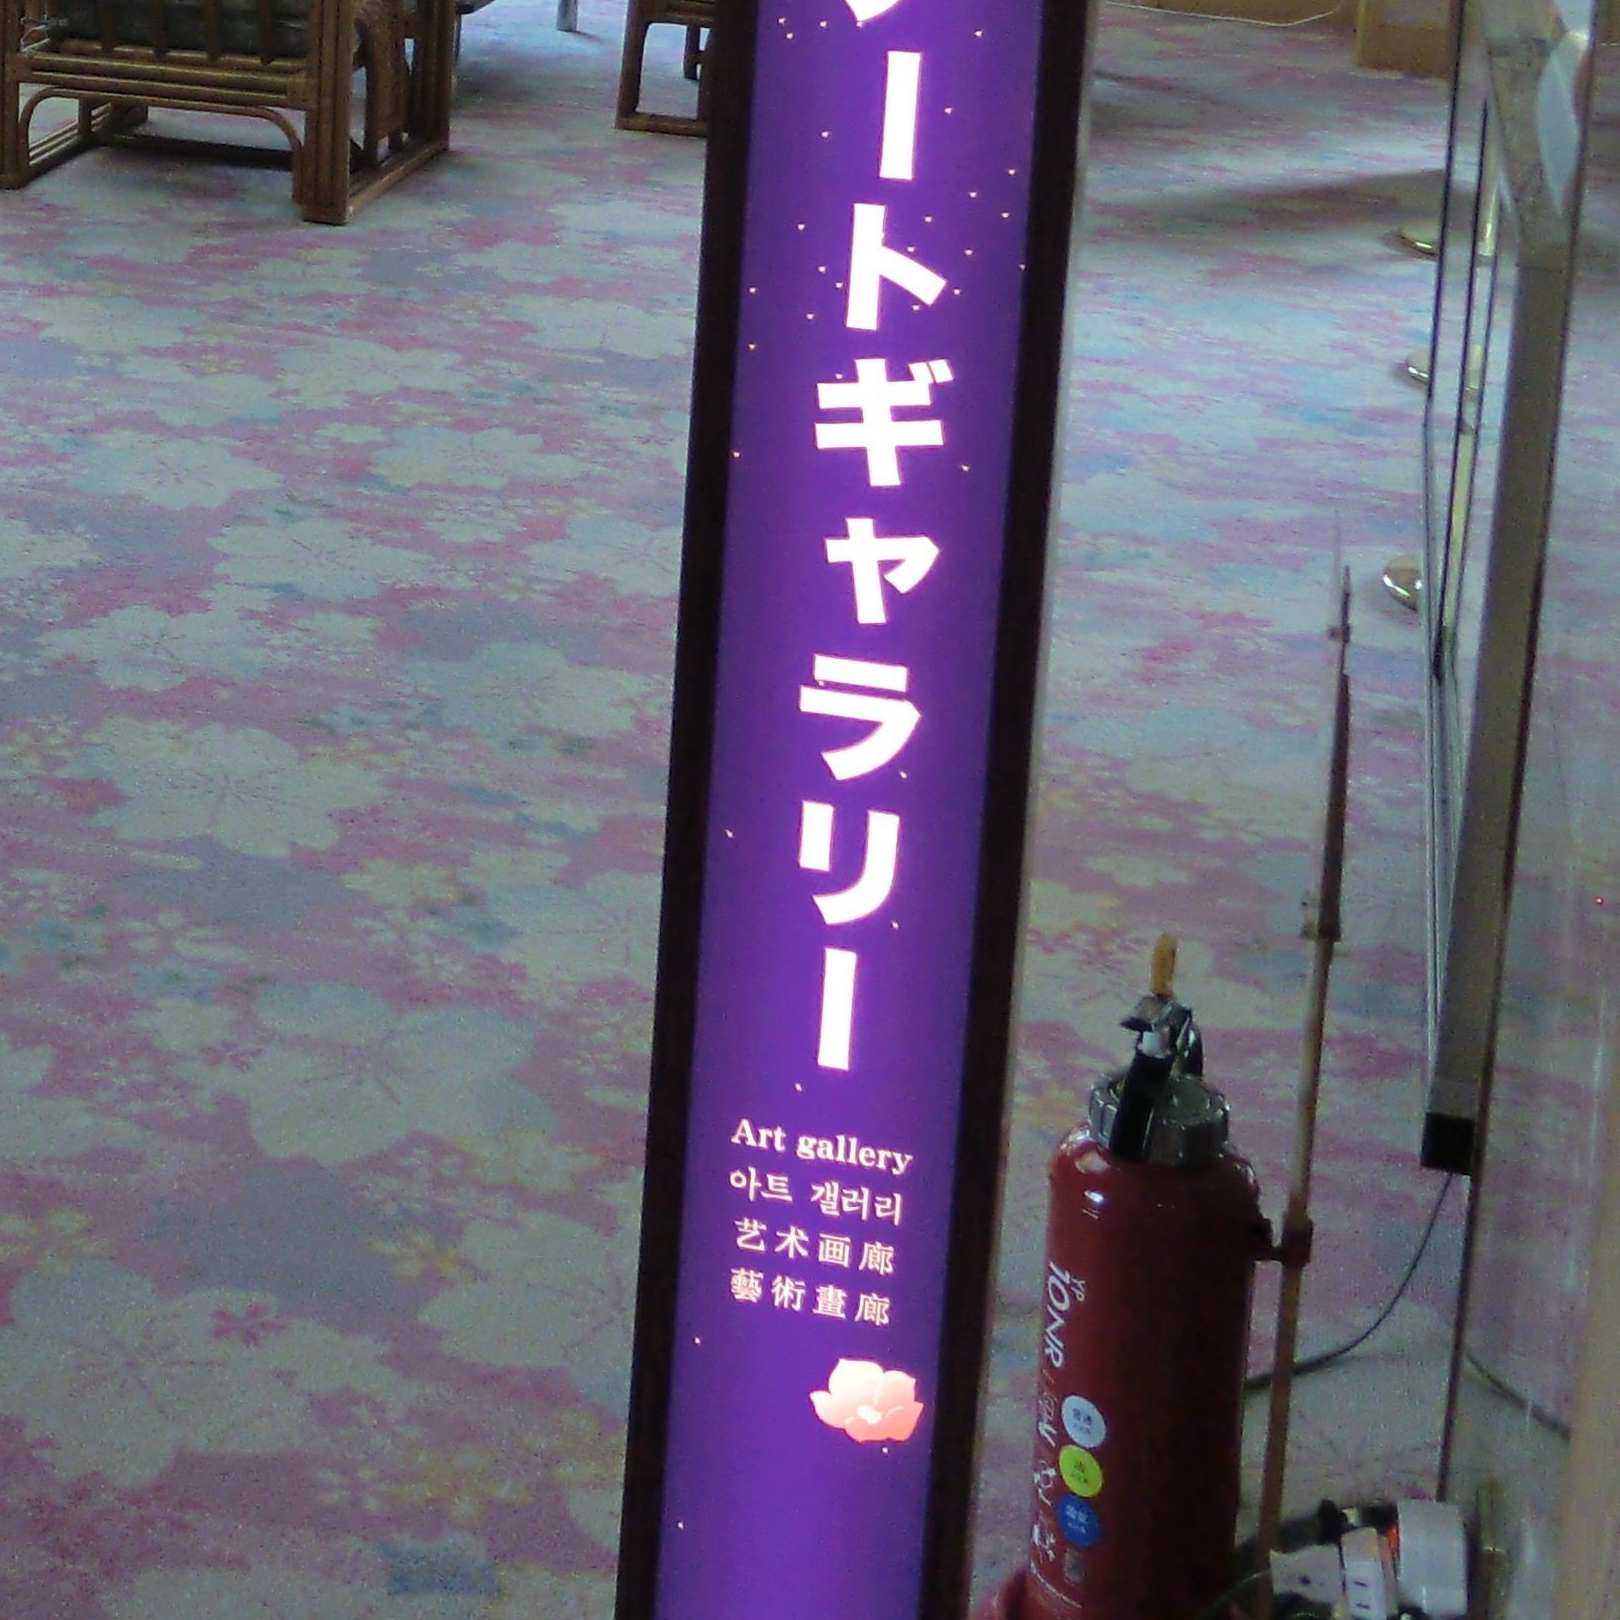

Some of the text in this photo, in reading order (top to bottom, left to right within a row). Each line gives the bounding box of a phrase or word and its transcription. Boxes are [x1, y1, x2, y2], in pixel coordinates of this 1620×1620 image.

[730, 1118, 914, 1176] Art gallery
[729, 1166, 903, 1226] 아트 갤러리
[733, 1217, 896, 1276] 艺术画廊
[729, 1267, 891, 1327] 藝術畫廊
